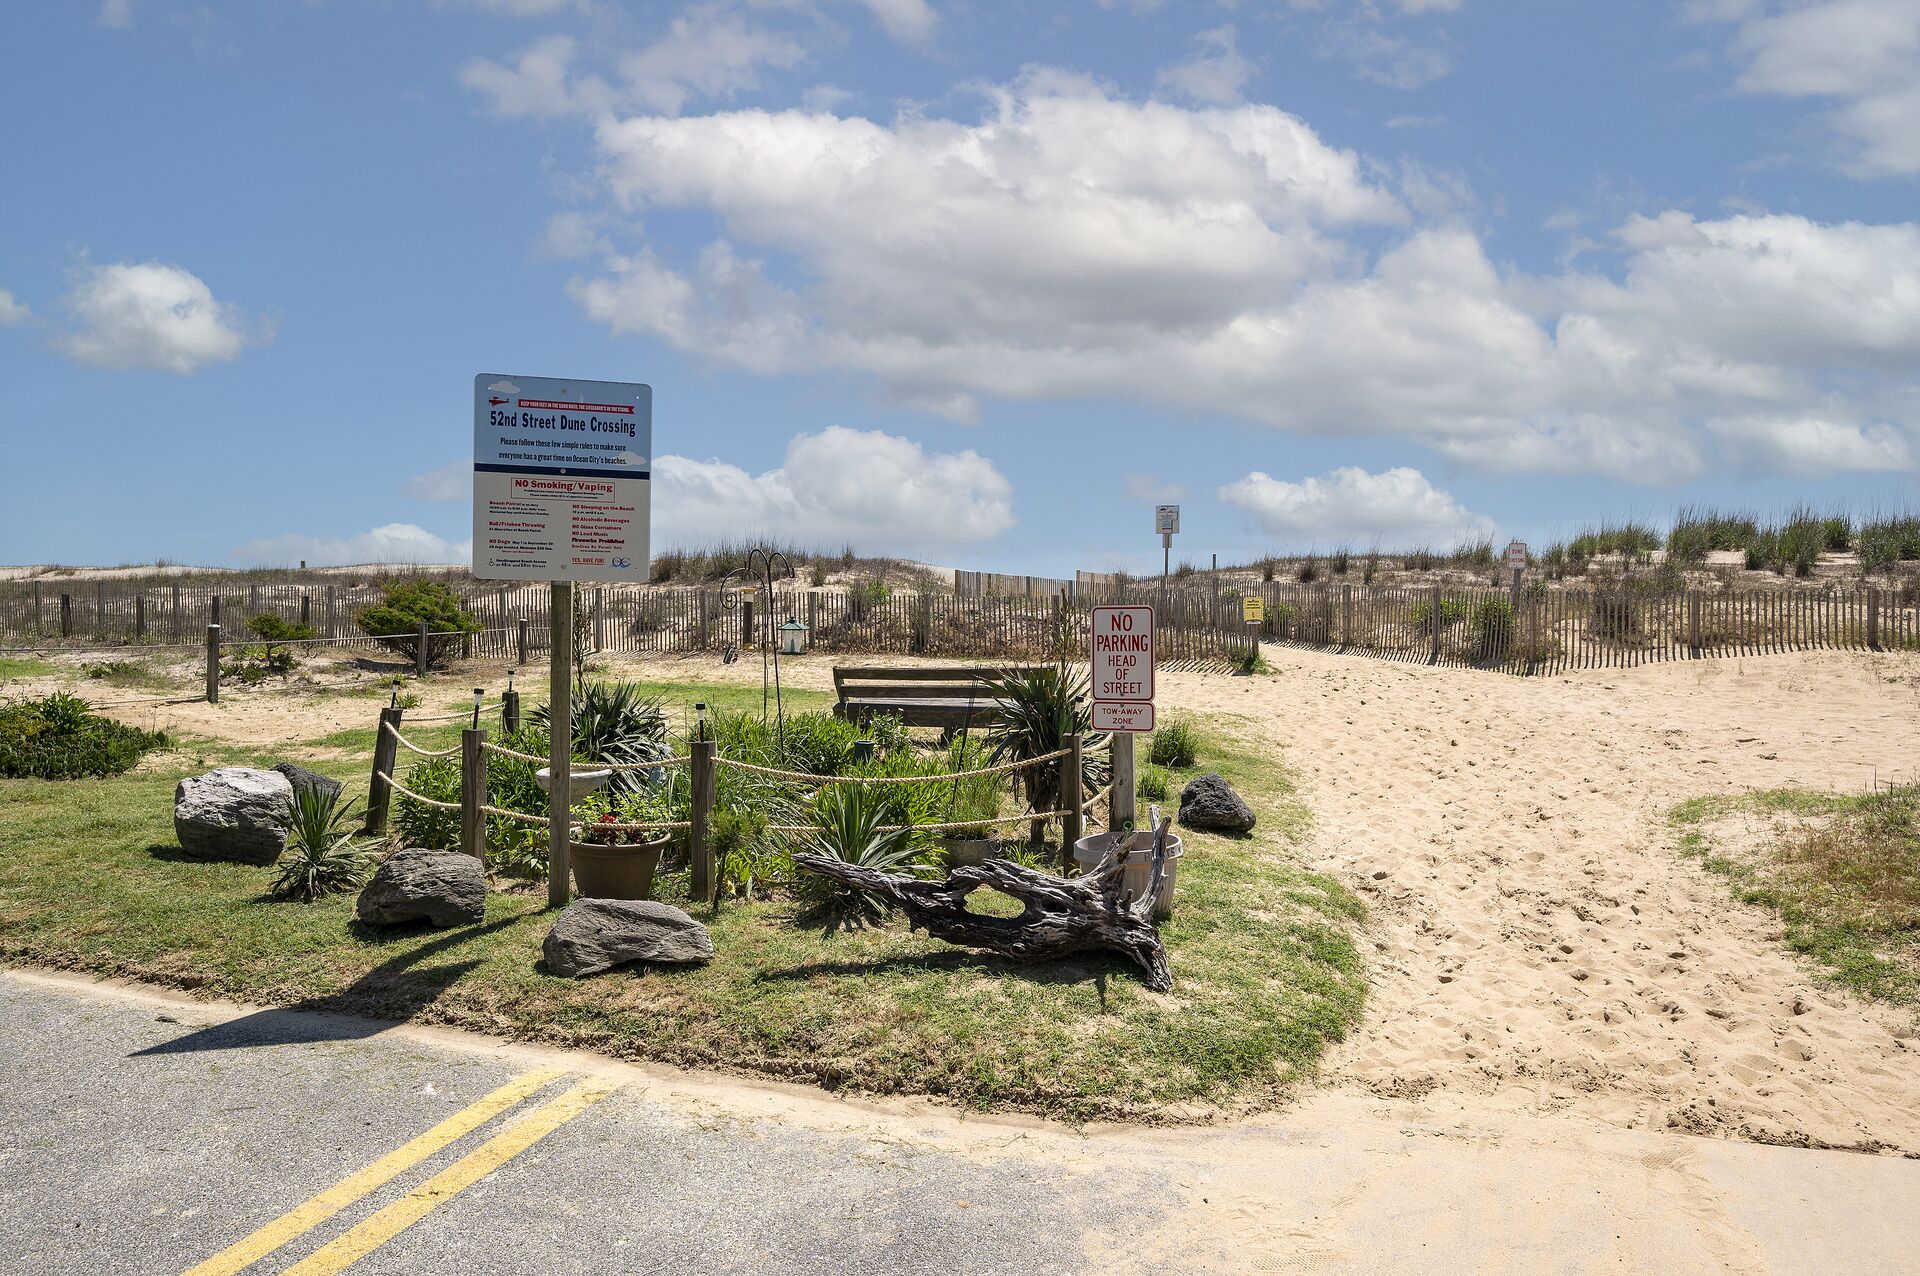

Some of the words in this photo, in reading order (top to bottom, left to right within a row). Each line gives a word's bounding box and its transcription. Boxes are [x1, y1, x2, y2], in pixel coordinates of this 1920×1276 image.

[490, 411, 516, 427] 52nd
[522, 412, 556, 429] Street
[561, 415, 585, 431] Dune
[591, 416, 636, 437] Crossing
[500, 437, 518, 445] Please
[562, 441, 579, 450] simple
[589, 456, 603, 464] City's
[531, 481, 612, 492] Smoking/Vaping
[1112, 614, 1132, 631] NO
[1097, 635, 1148, 651] PARKING
[1108, 655, 1136, 666] HEAD
[1116, 669, 1129, 680] OF
[1103, 682, 1142, 694] STREET
